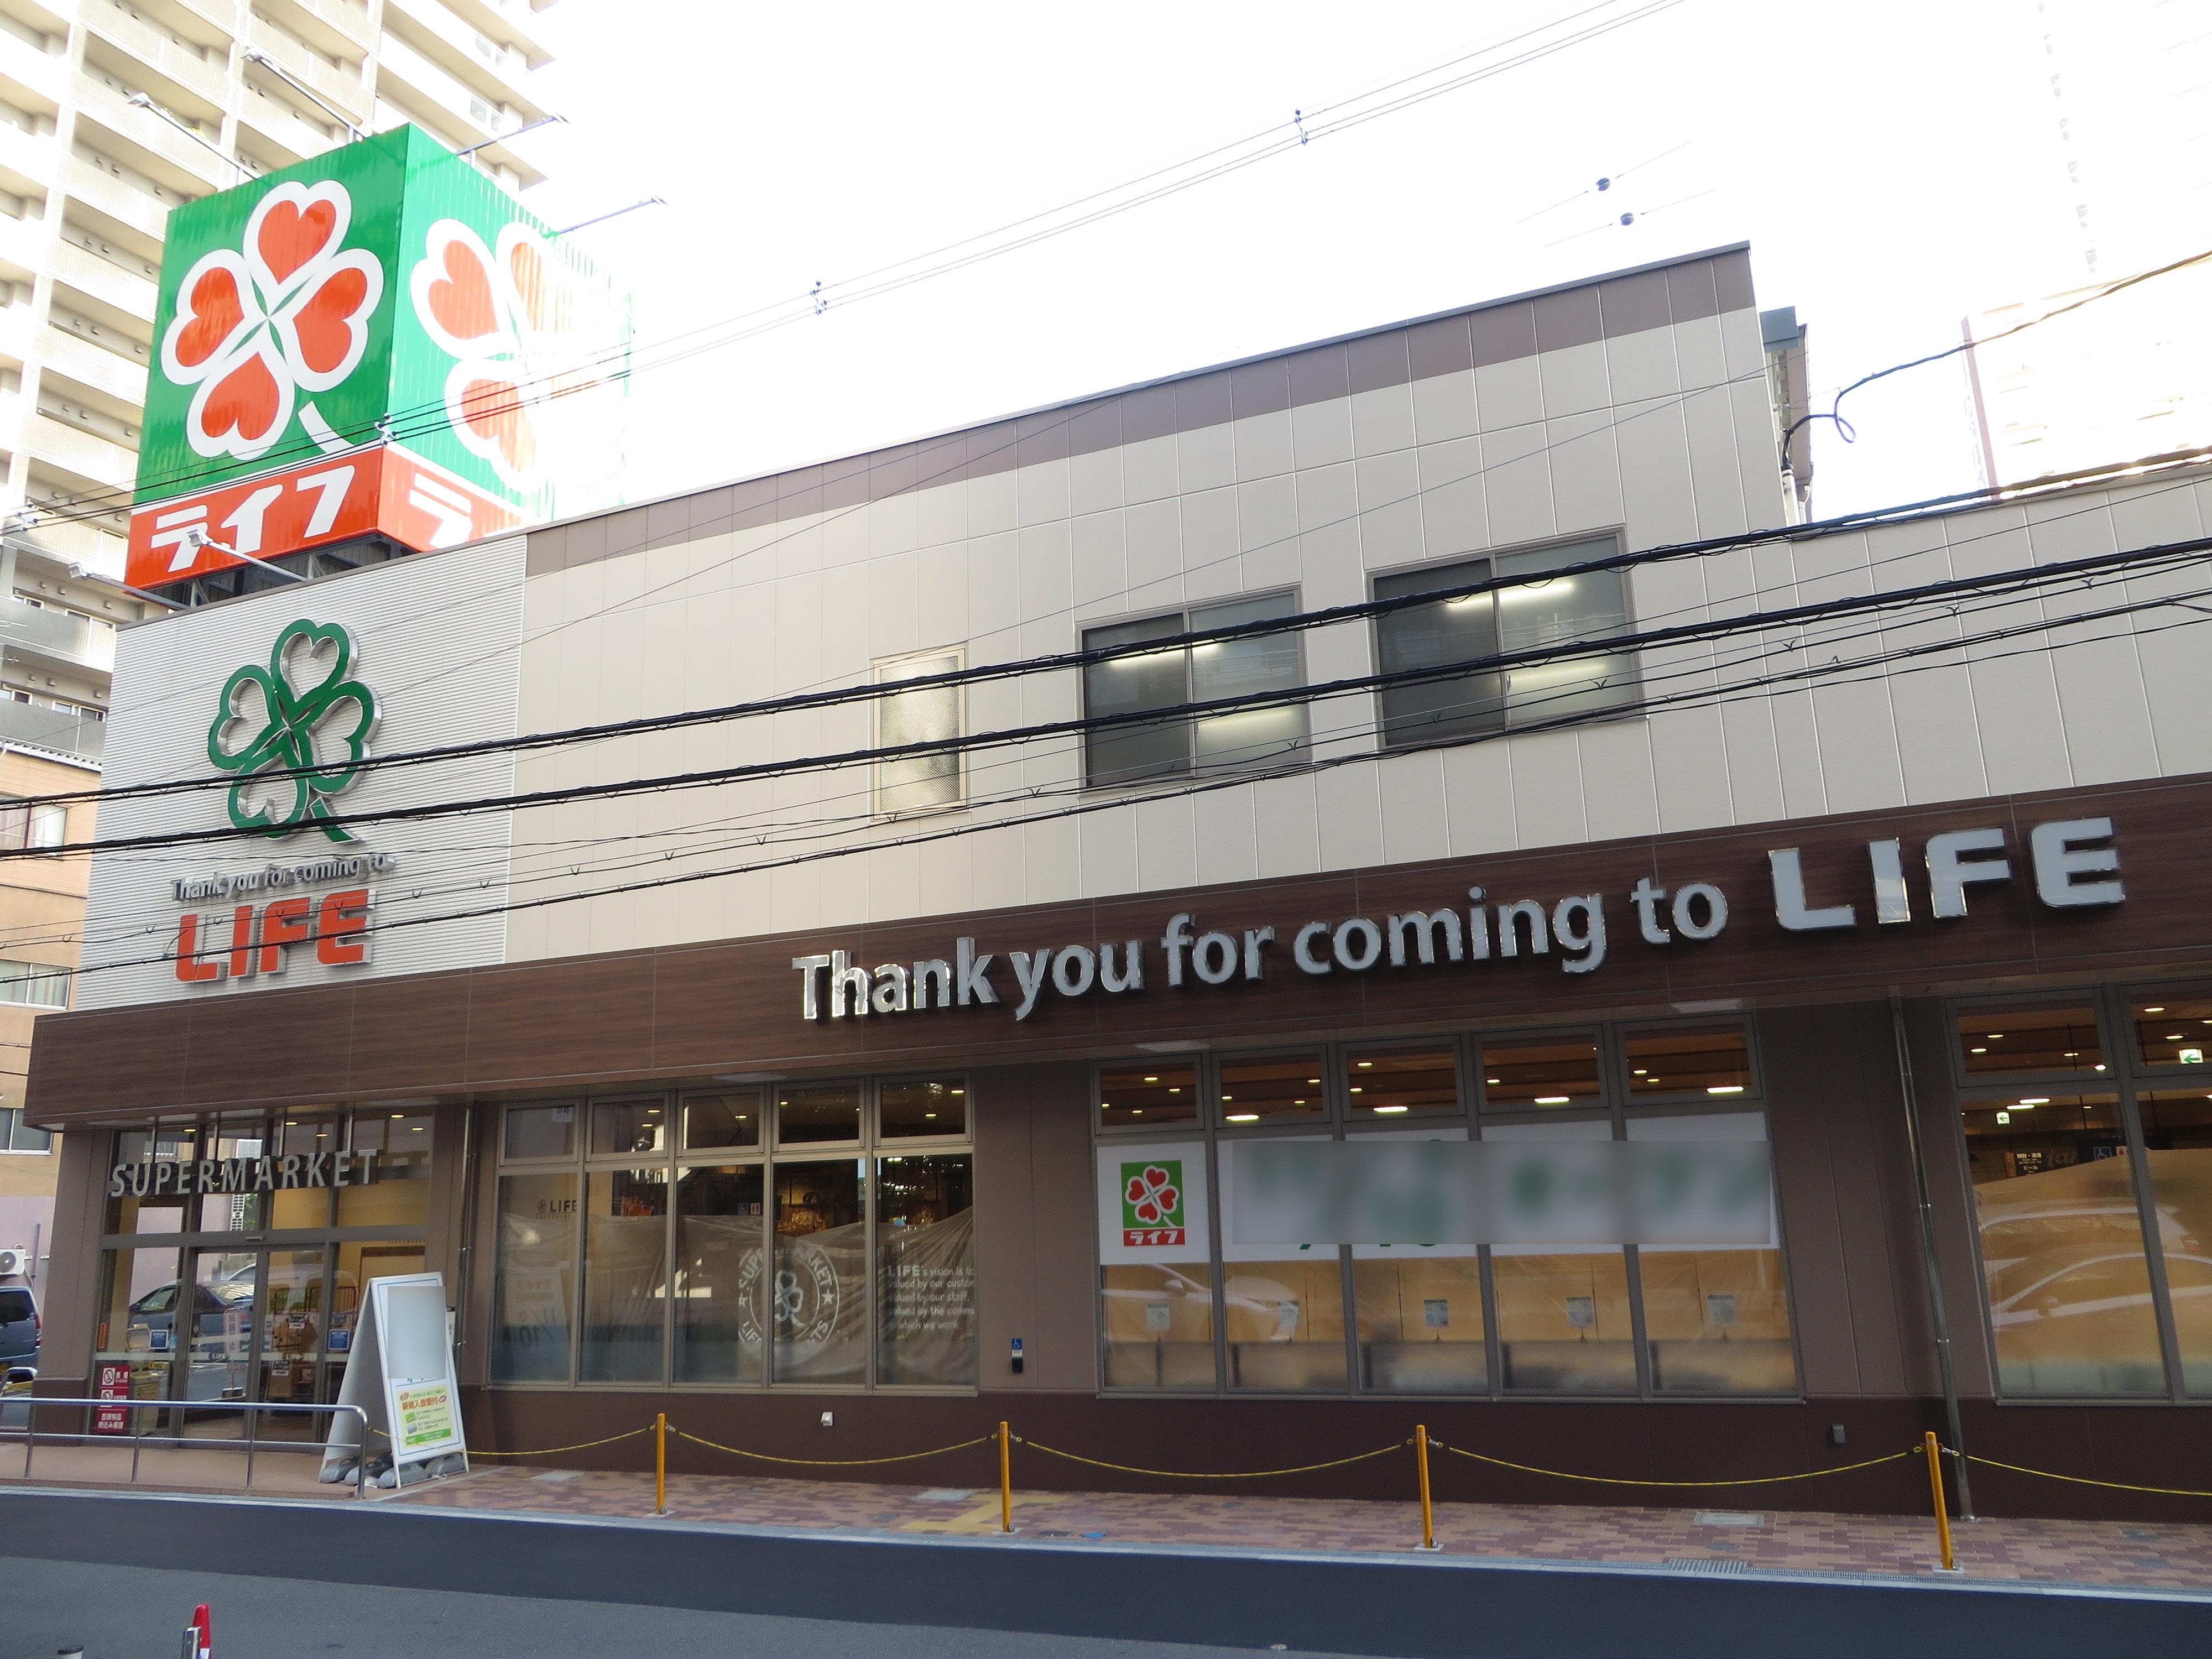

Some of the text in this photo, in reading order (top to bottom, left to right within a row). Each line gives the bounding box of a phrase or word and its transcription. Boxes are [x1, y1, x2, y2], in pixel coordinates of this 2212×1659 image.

[150, 465, 356, 573] ライフ
[171, 854, 388, 900] Thank you for coming to
[792, 816, 2127, 1021] Thank you for coming to LIFE
[175, 889, 369, 982] LIFE
[111, 1148, 378, 1197] SUPERMARKET
[550, 1200, 576, 1213] LIFE
[1130, 1230, 1178, 1245] ライフ
[888, 1265, 928, 1277] LIFE's
[930, 1267, 954, 1276] vision
[956, 1267, 963, 1276] is
[917, 1278, 927, 1291] by
[930, 1305, 944, 1315] the
